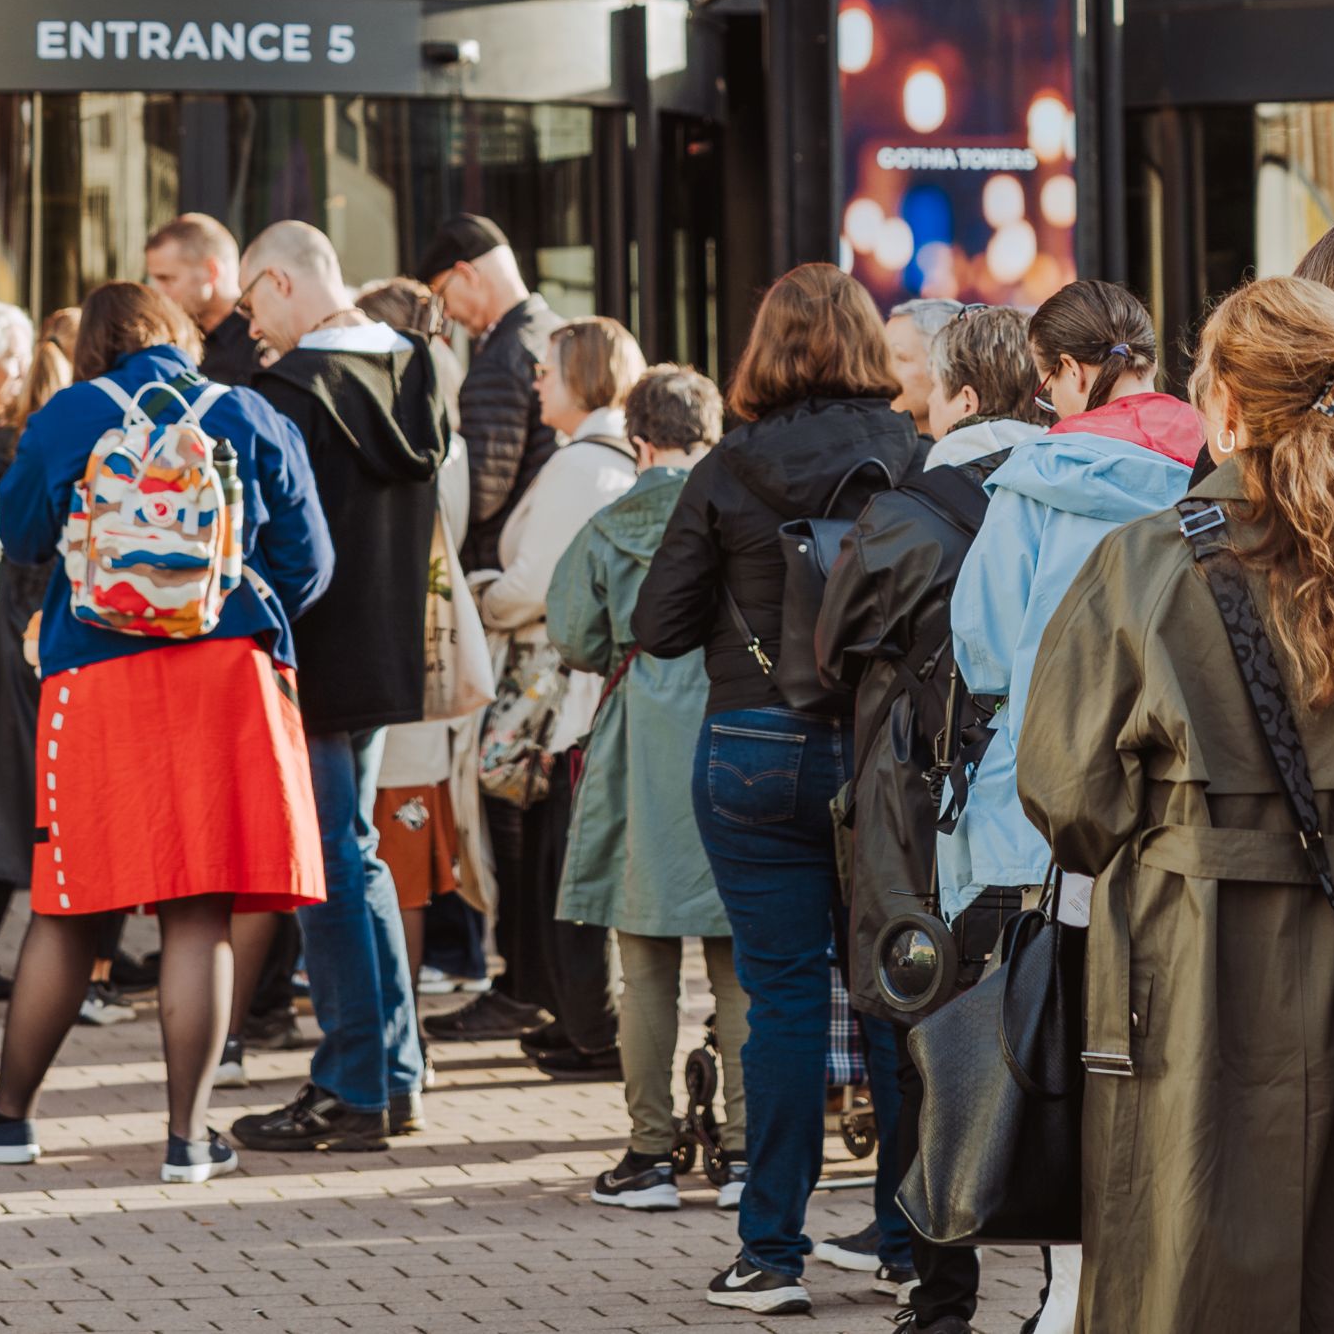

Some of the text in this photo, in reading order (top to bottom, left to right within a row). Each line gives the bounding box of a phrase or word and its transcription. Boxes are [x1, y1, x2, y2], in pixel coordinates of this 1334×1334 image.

[36, 20, 356, 64] ENTRANCE 5
[876, 146, 1039, 172] GOTHIA TOWERS
